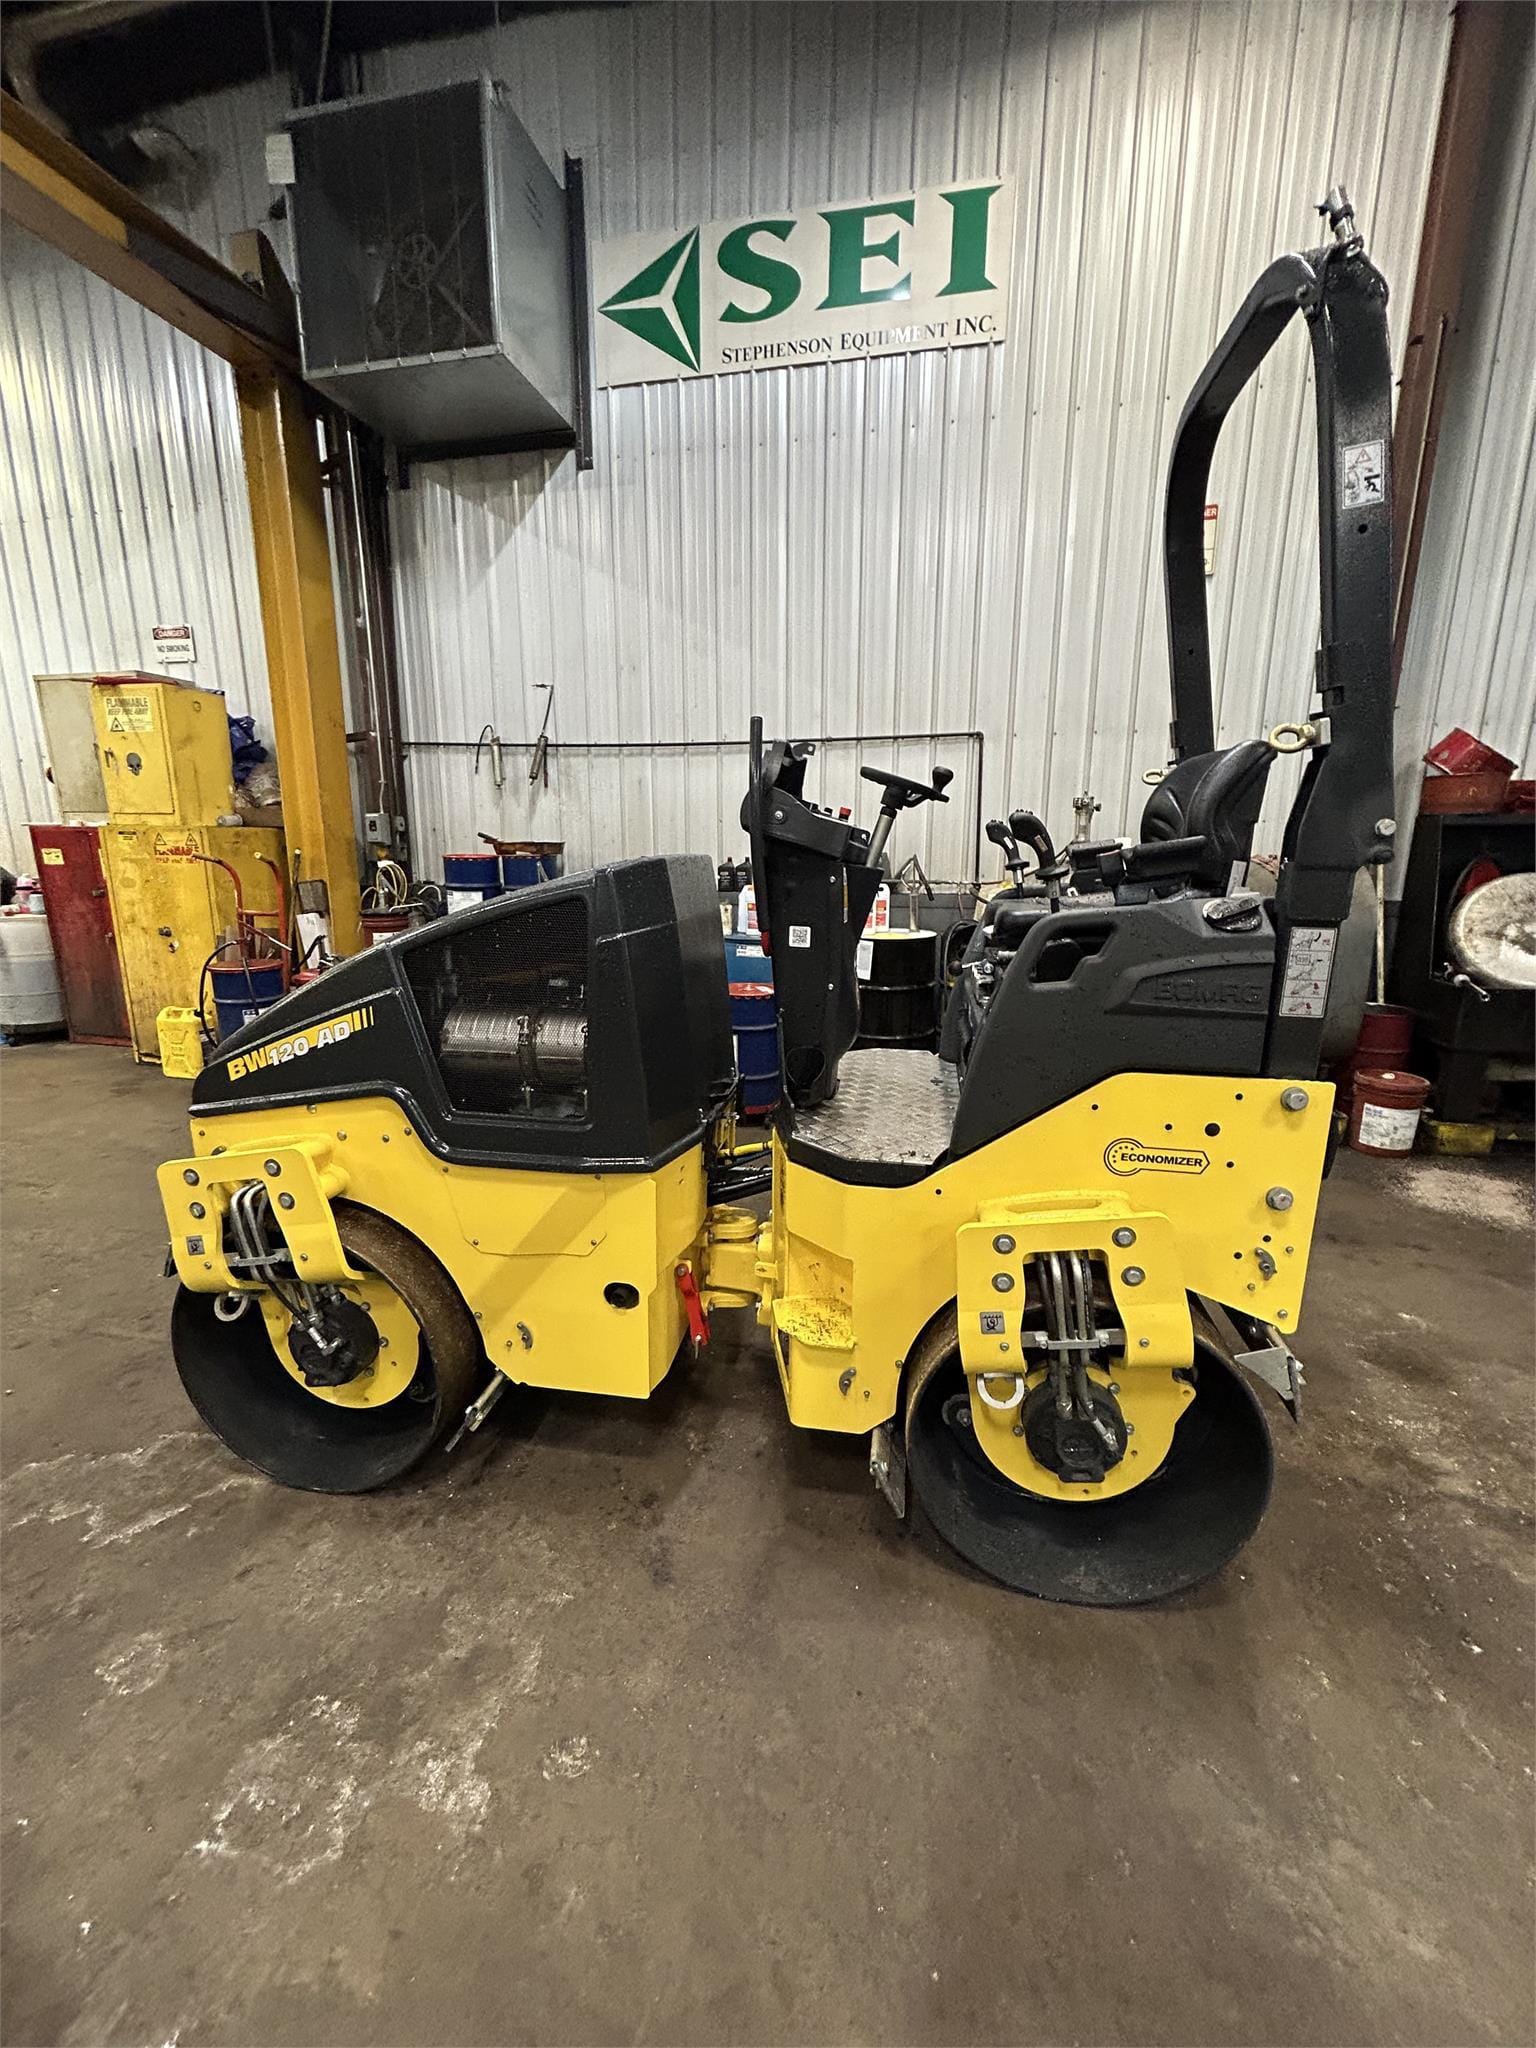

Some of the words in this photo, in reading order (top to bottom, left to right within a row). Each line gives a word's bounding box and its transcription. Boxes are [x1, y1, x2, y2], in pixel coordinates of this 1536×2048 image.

[717, 184, 1004, 323] SEI
[721, 336, 833, 364] STEPHENSON
[955, 314, 997, 336] INC.
[157, 629, 186, 638] DANGER
[166, 644, 190, 652] SMOKING
[1120, 1152, 1203, 1167] ECONOMIZER
